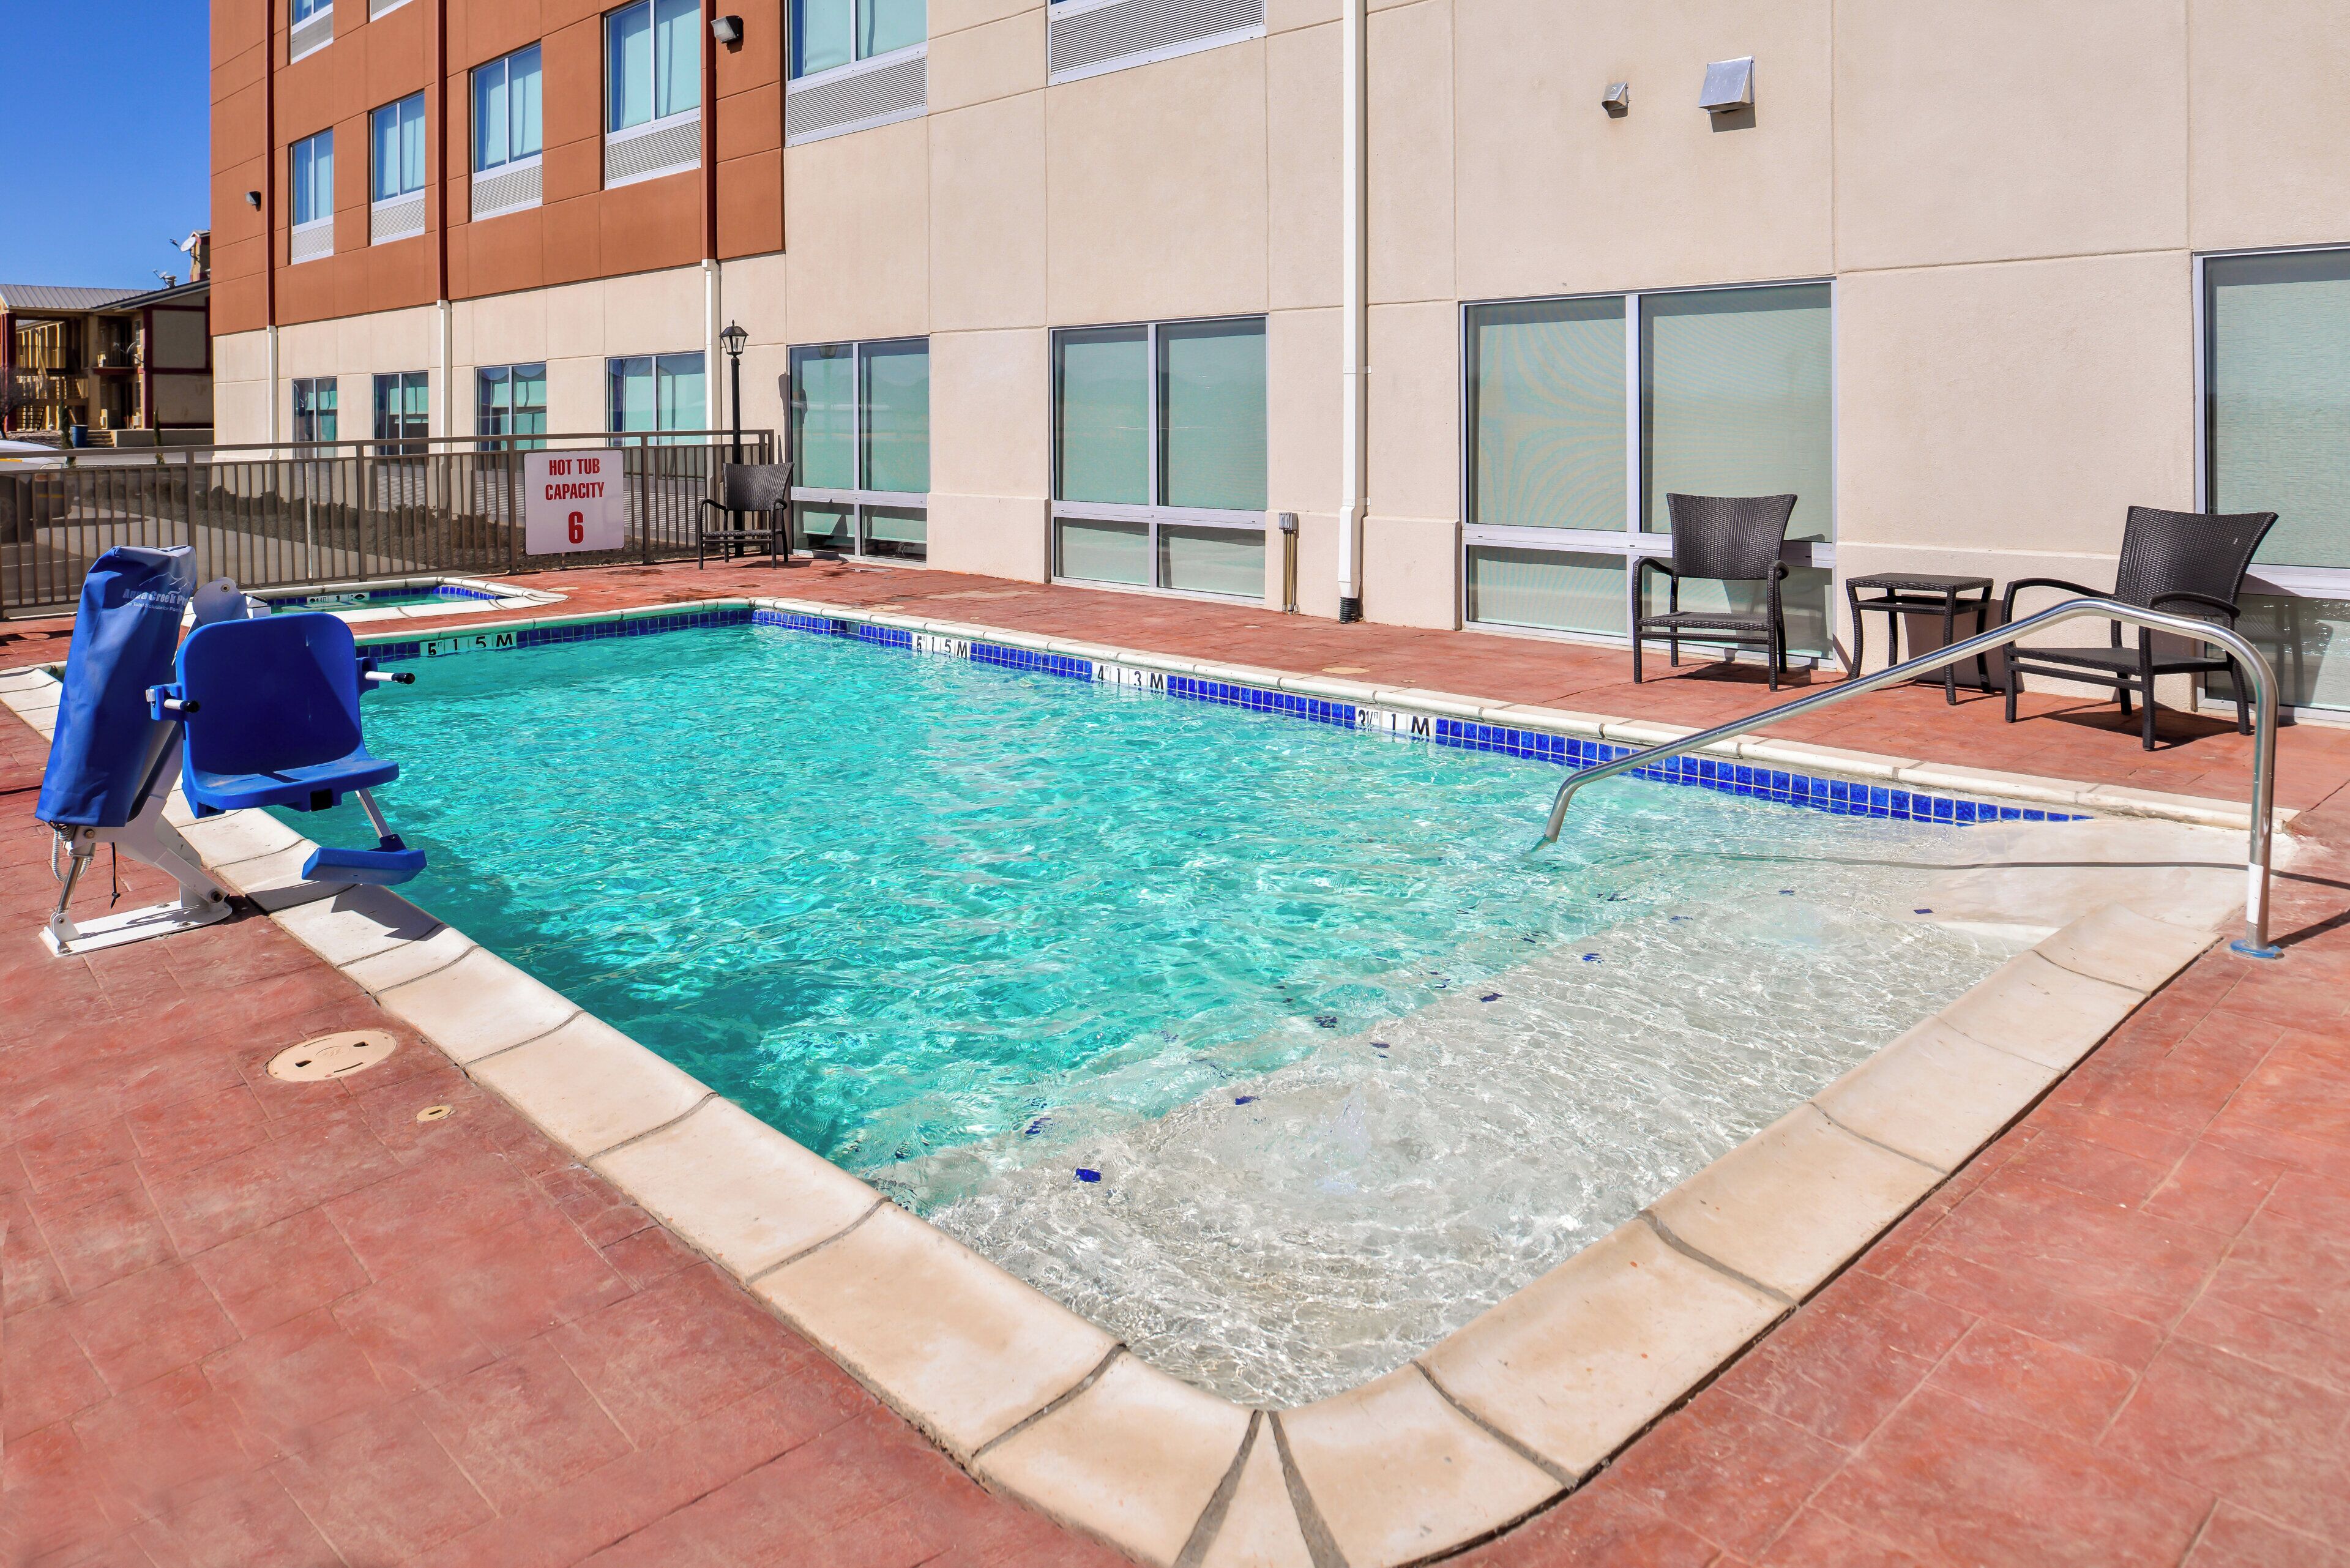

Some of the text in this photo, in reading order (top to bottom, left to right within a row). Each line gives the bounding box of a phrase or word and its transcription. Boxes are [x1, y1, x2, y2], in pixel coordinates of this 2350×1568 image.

[549, 458, 600, 476] HOT TUB
[545, 482, 605, 501] CAPACITY
[568, 511, 584, 544] 6
[123, 589, 147, 600] Aqua
[149, 591, 176, 604] Creek
[428, 642, 436, 655] 5
[453, 638, 458, 651] 1
[475, 636, 487, 649] 5
[496, 633, 513, 648] M
[944, 639, 952, 654] 5
[957, 641, 968, 659] M
[1133, 671, 1142, 686] 3
[1150, 673, 1164, 690] M
[1411, 716, 1430, 737] M
